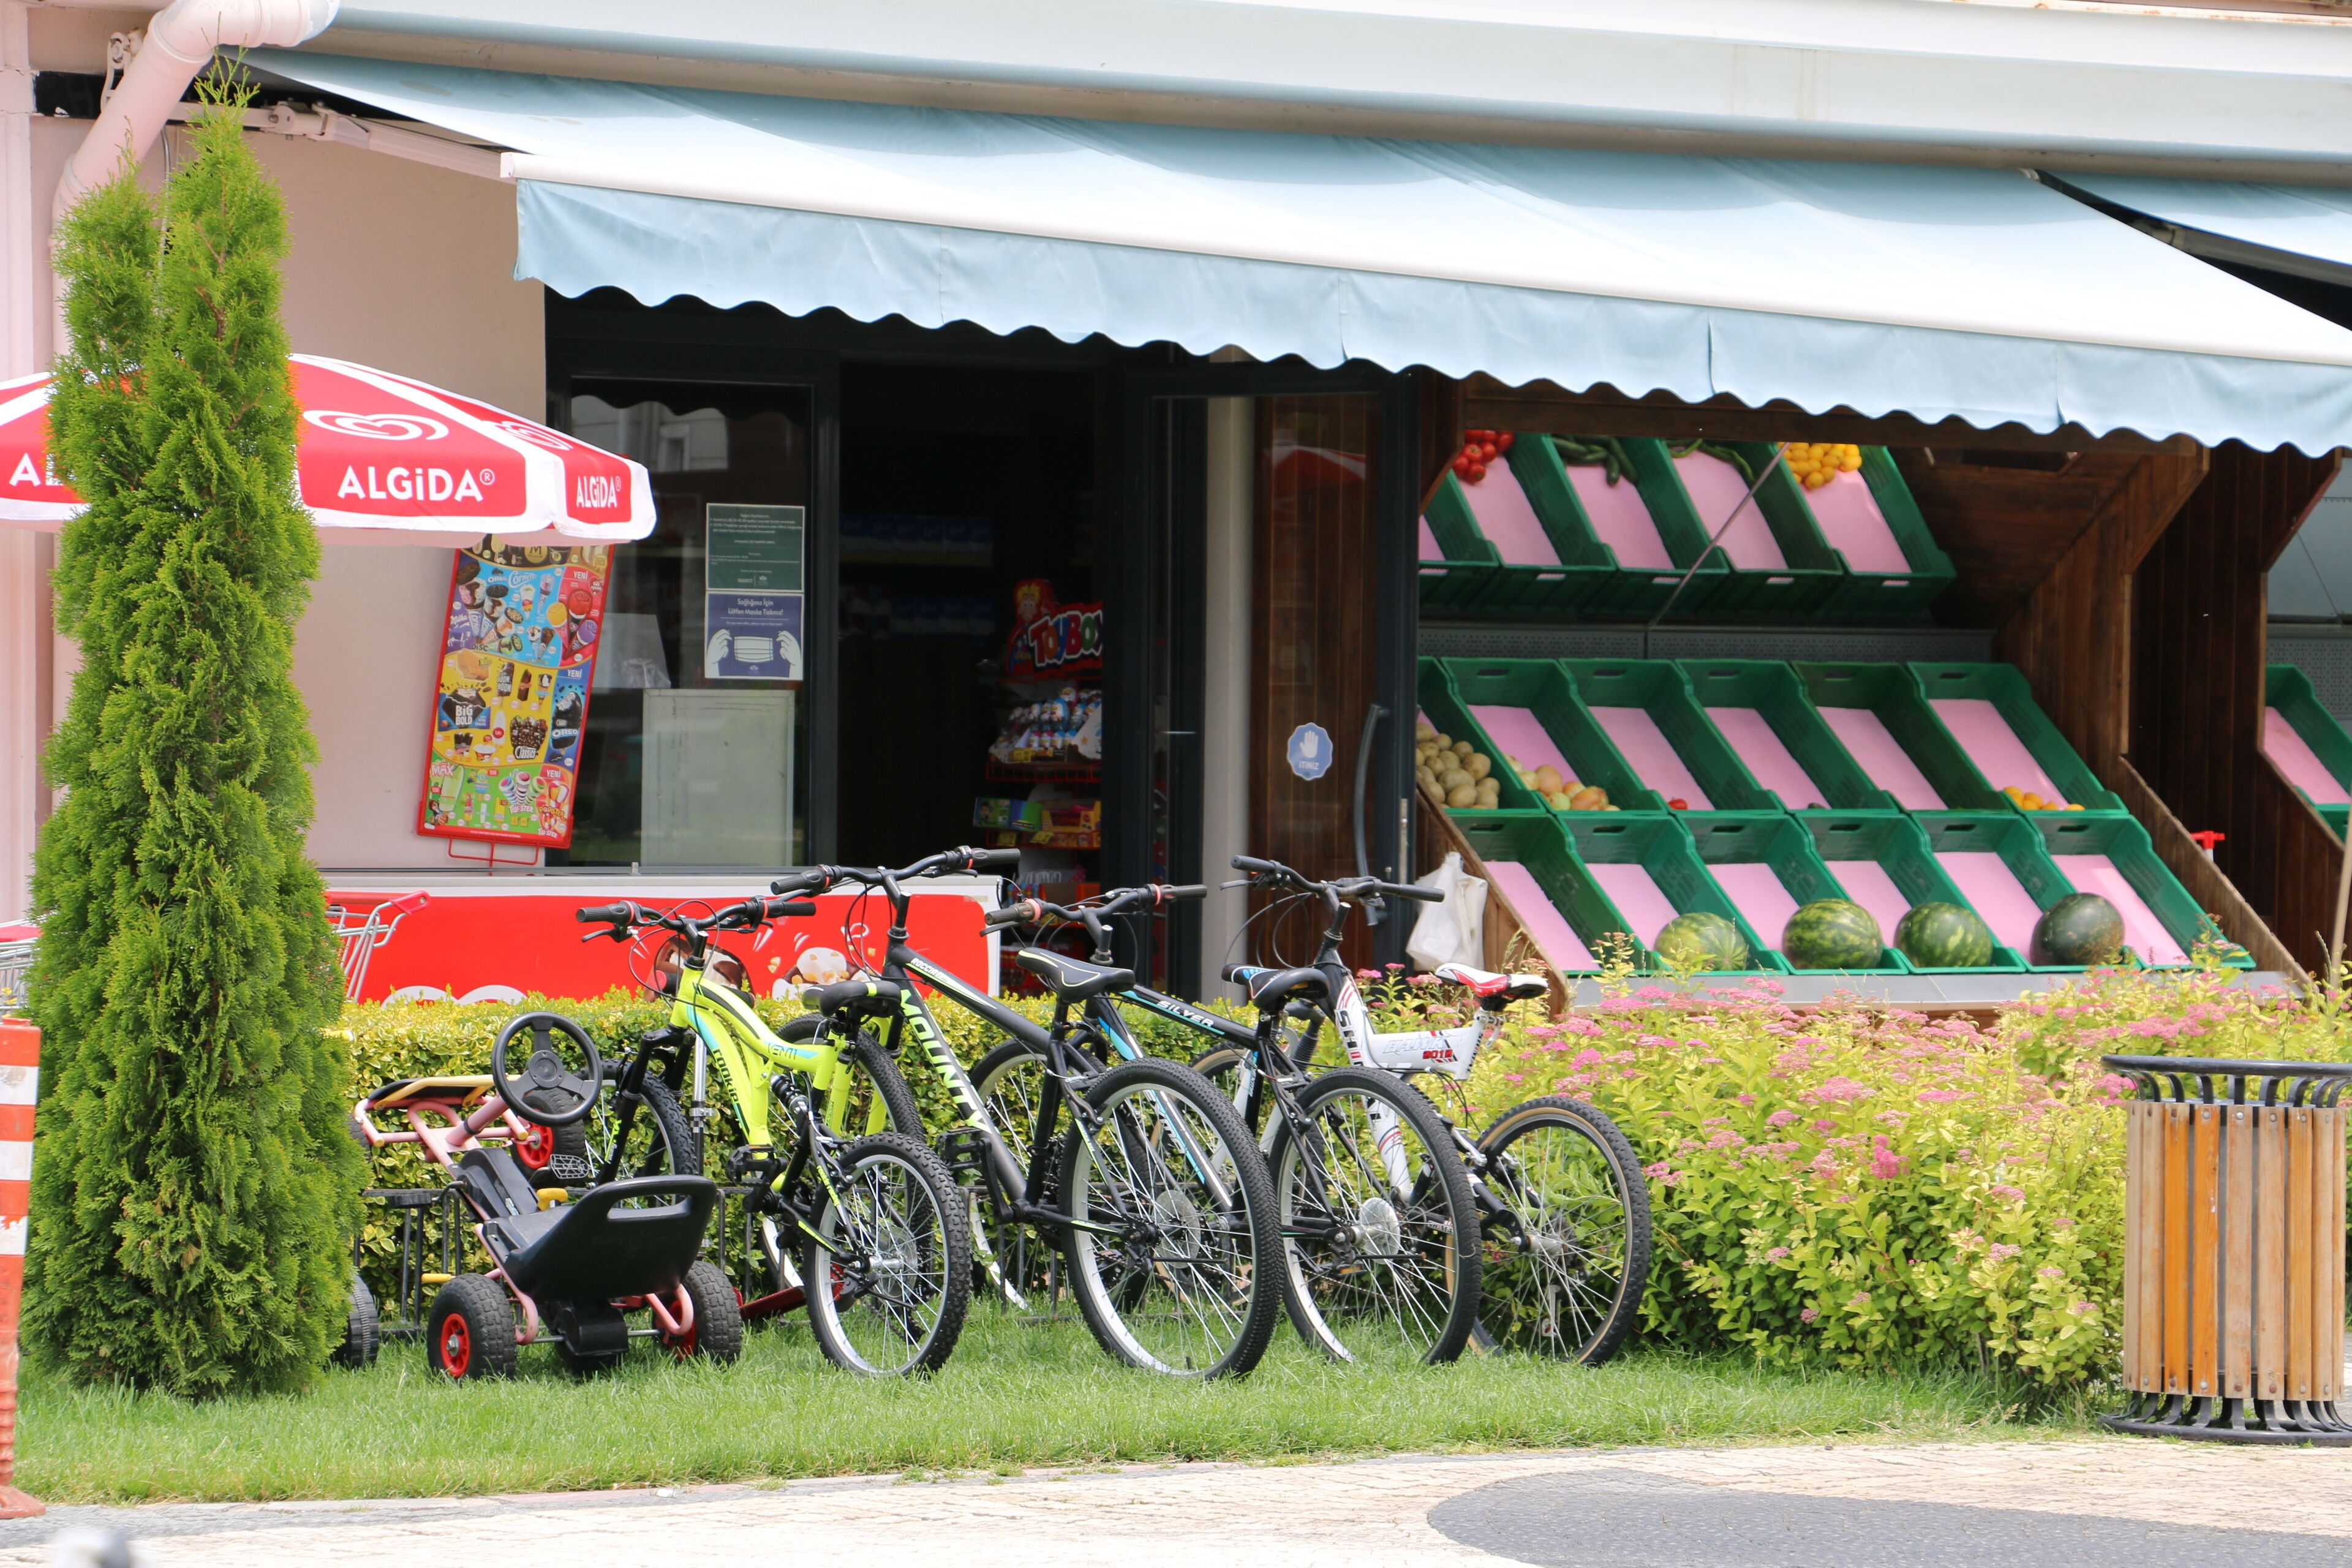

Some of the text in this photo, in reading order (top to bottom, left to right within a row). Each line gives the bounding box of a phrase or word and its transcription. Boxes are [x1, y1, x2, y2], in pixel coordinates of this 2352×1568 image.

[498, 683, 511, 692] BOOM
[455, 716, 473, 726] BOLD
[552, 729, 579, 737] OREO
[431, 764, 454, 777] MAX
[910, 957, 940, 976] ROCCIA
[1156, 1000, 1214, 1027] SILVER
[1382, 1036, 1449, 1055] HAWK
[900, 989, 995, 1134] MOUNTY
[712, 1048, 739, 1104] rookie
